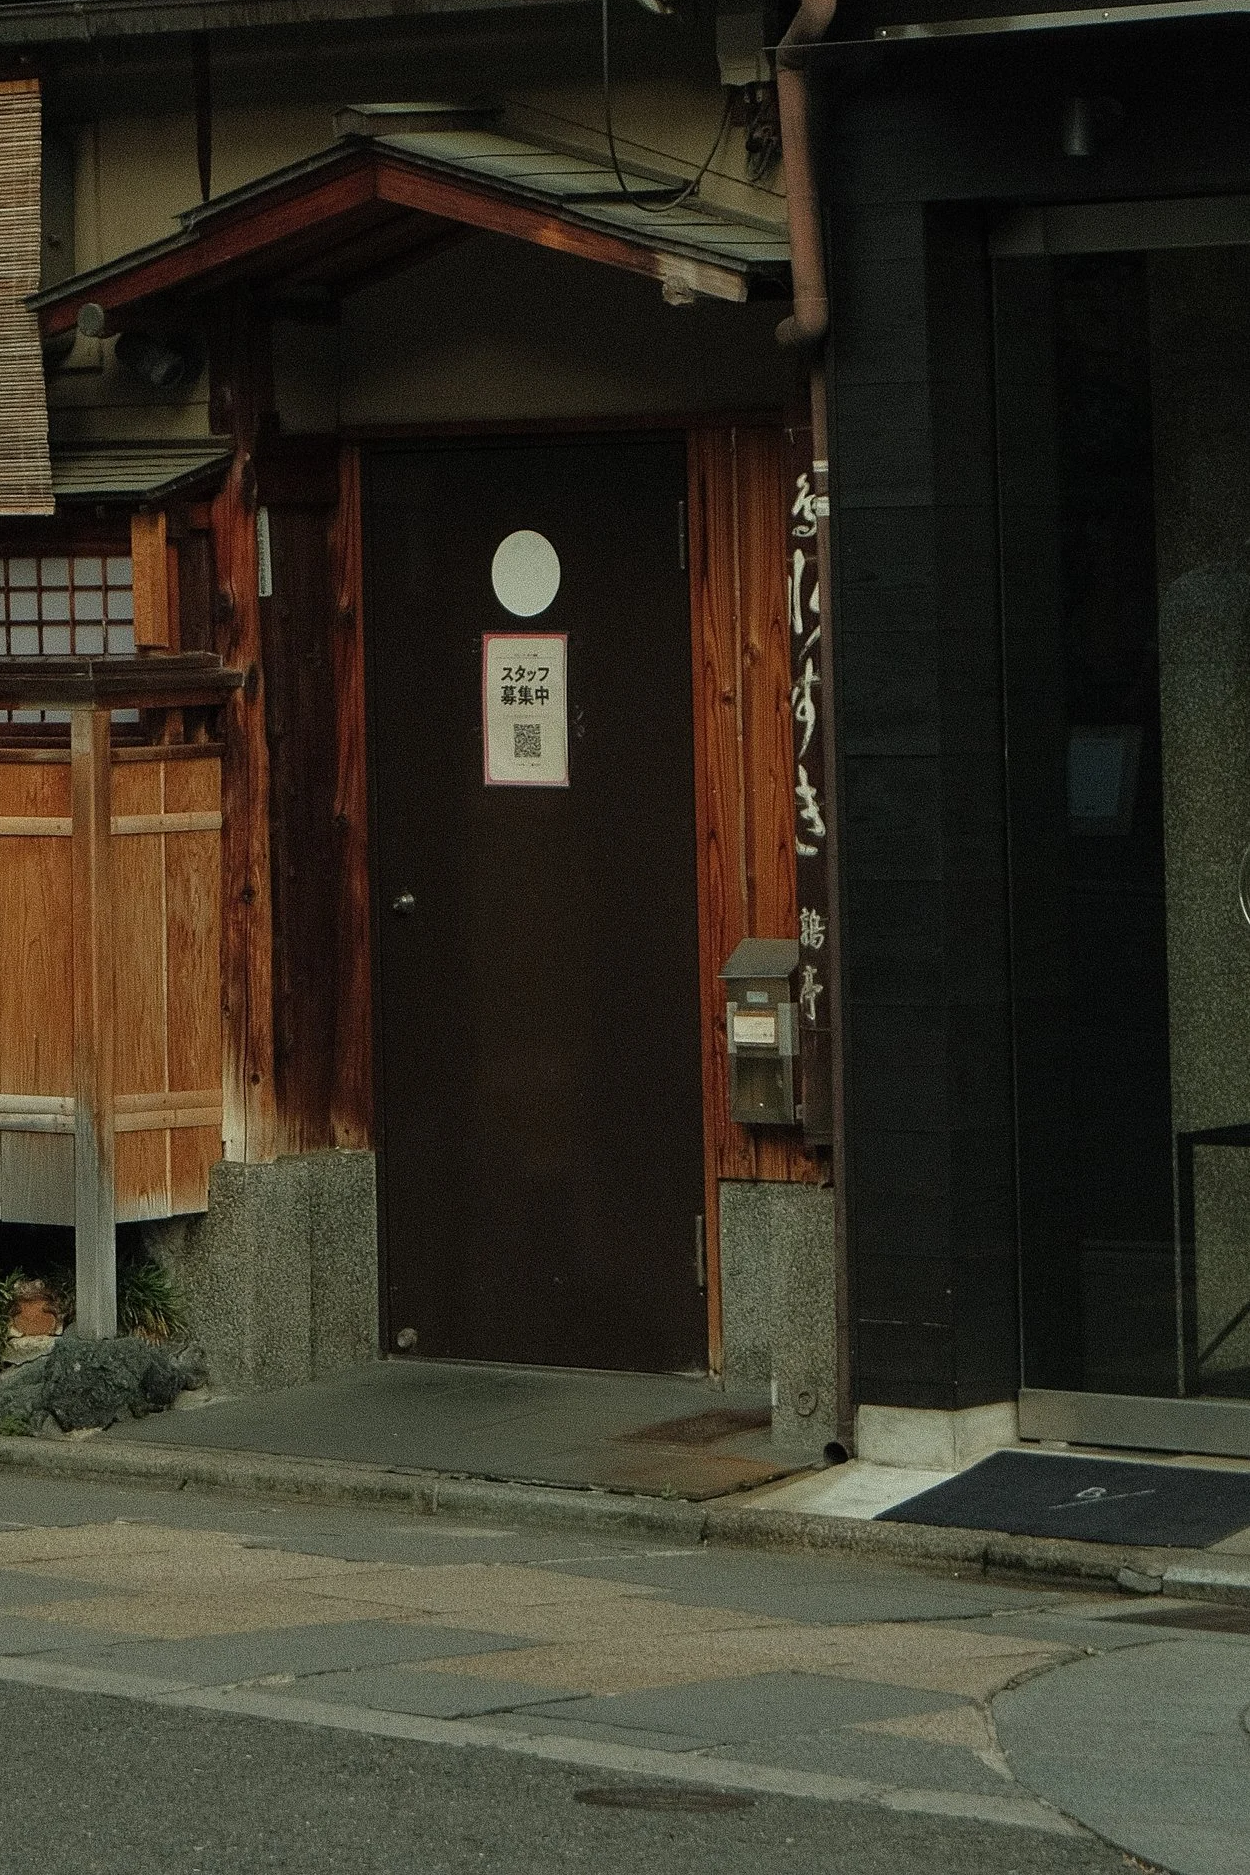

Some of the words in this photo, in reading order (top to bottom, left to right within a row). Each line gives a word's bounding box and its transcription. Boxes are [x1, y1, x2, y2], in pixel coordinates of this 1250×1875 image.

[500, 664, 550, 682] スタッフ
[500, 685, 550, 706] 募集中
